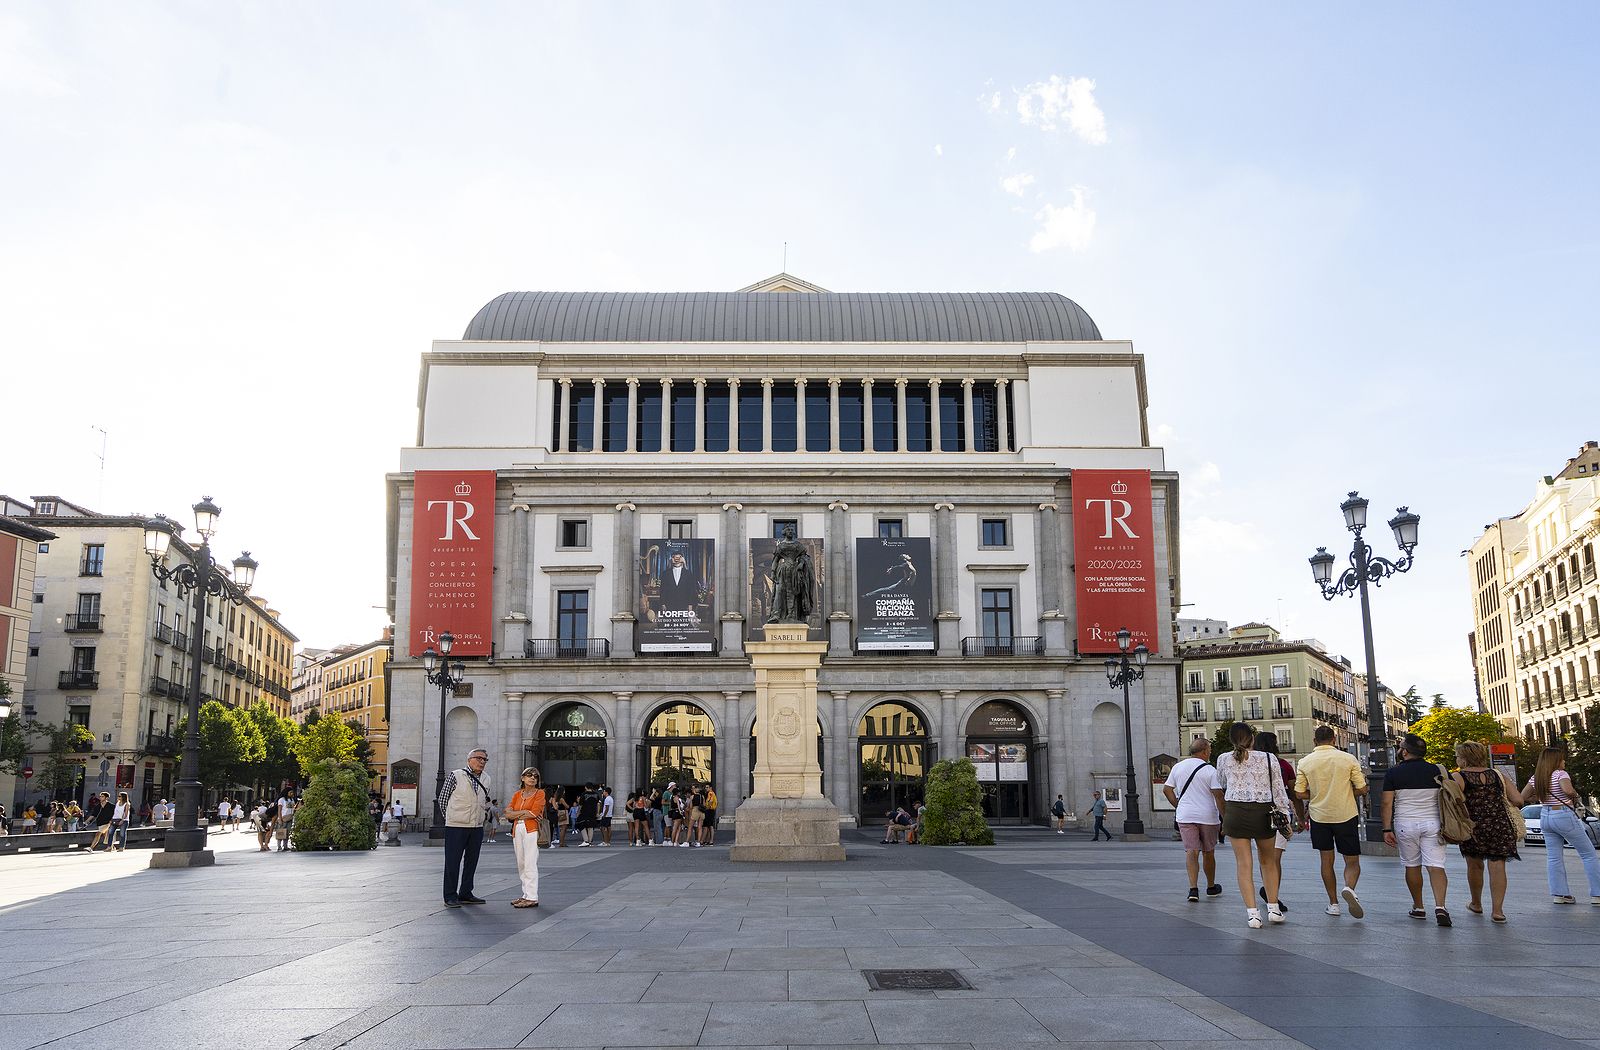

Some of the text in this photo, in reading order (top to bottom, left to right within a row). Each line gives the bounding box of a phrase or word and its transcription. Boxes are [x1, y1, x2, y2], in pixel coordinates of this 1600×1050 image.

[427, 500, 481, 540] TR
[1085, 499, 1140, 539] TR
[1087, 559, 1142, 570] 2020/2023
